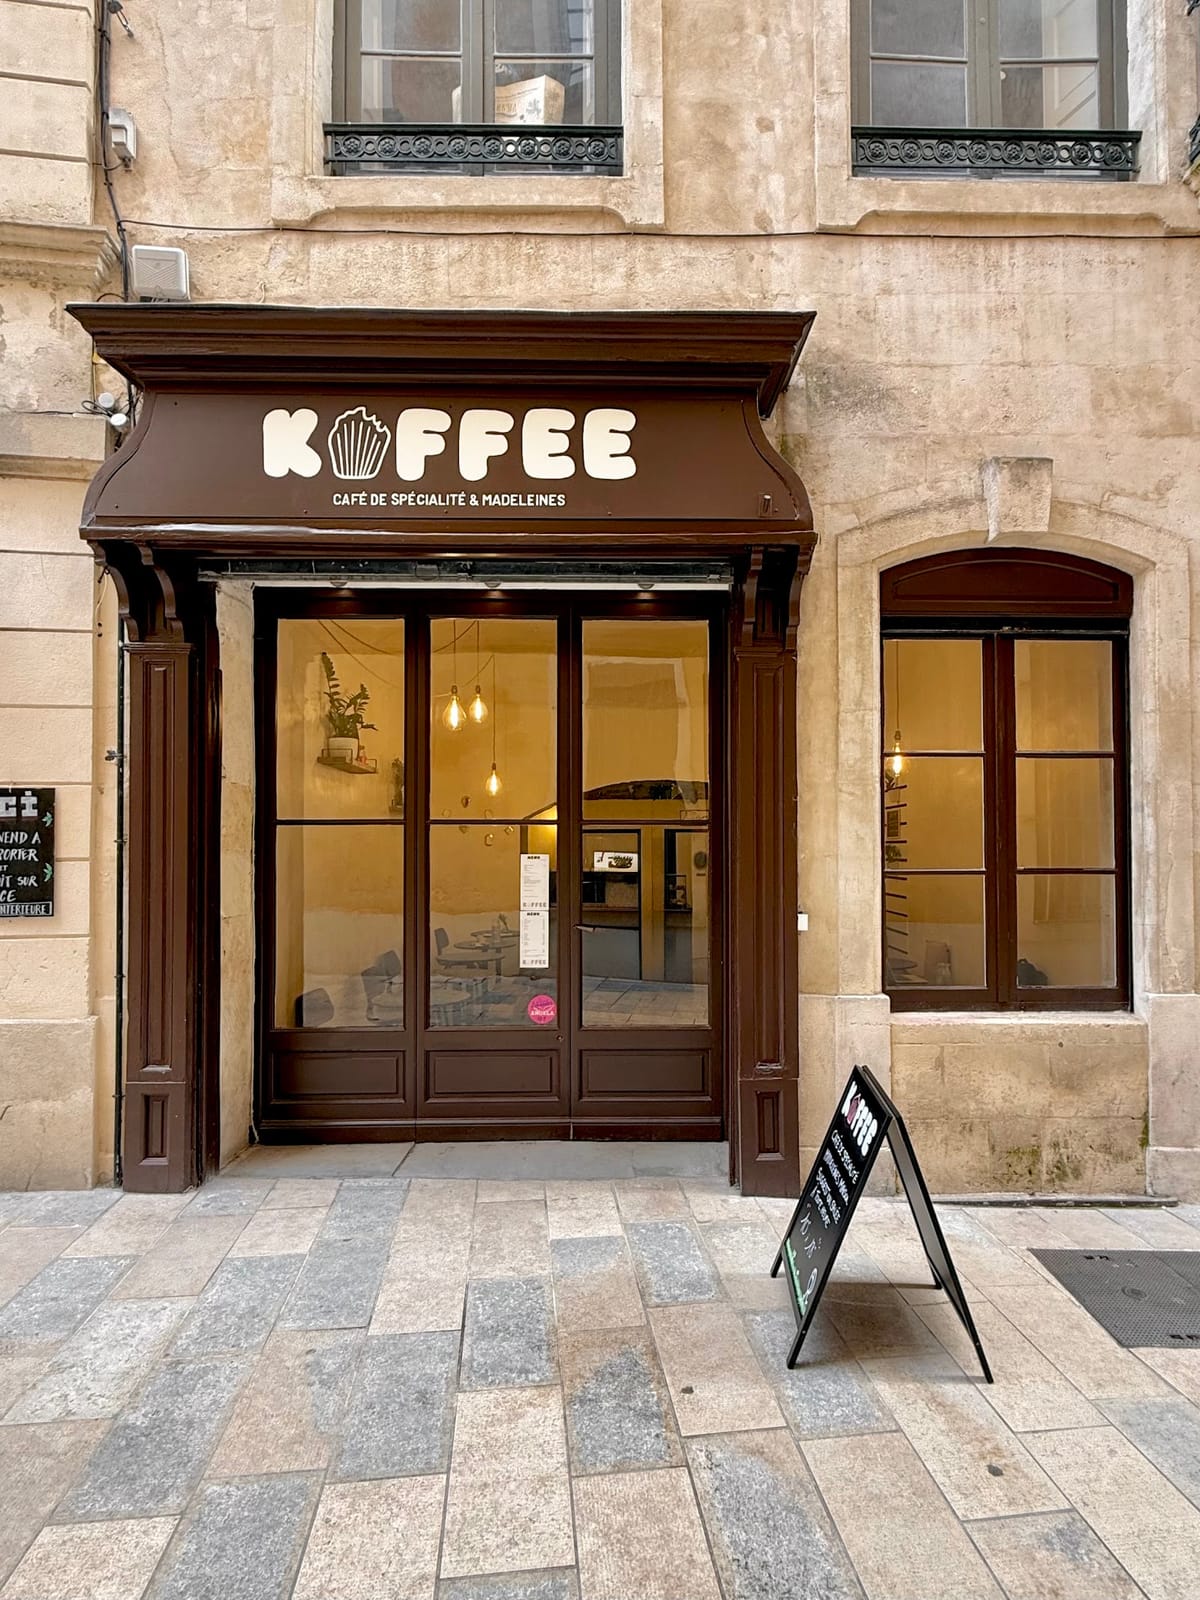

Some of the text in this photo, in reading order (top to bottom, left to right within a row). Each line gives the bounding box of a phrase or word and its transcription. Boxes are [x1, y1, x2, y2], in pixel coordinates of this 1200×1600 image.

[333, 491, 566, 507] CAFÉ DE SPÉCIALITÉ & MADELEINES
[17, 875, 39, 888] SUR
